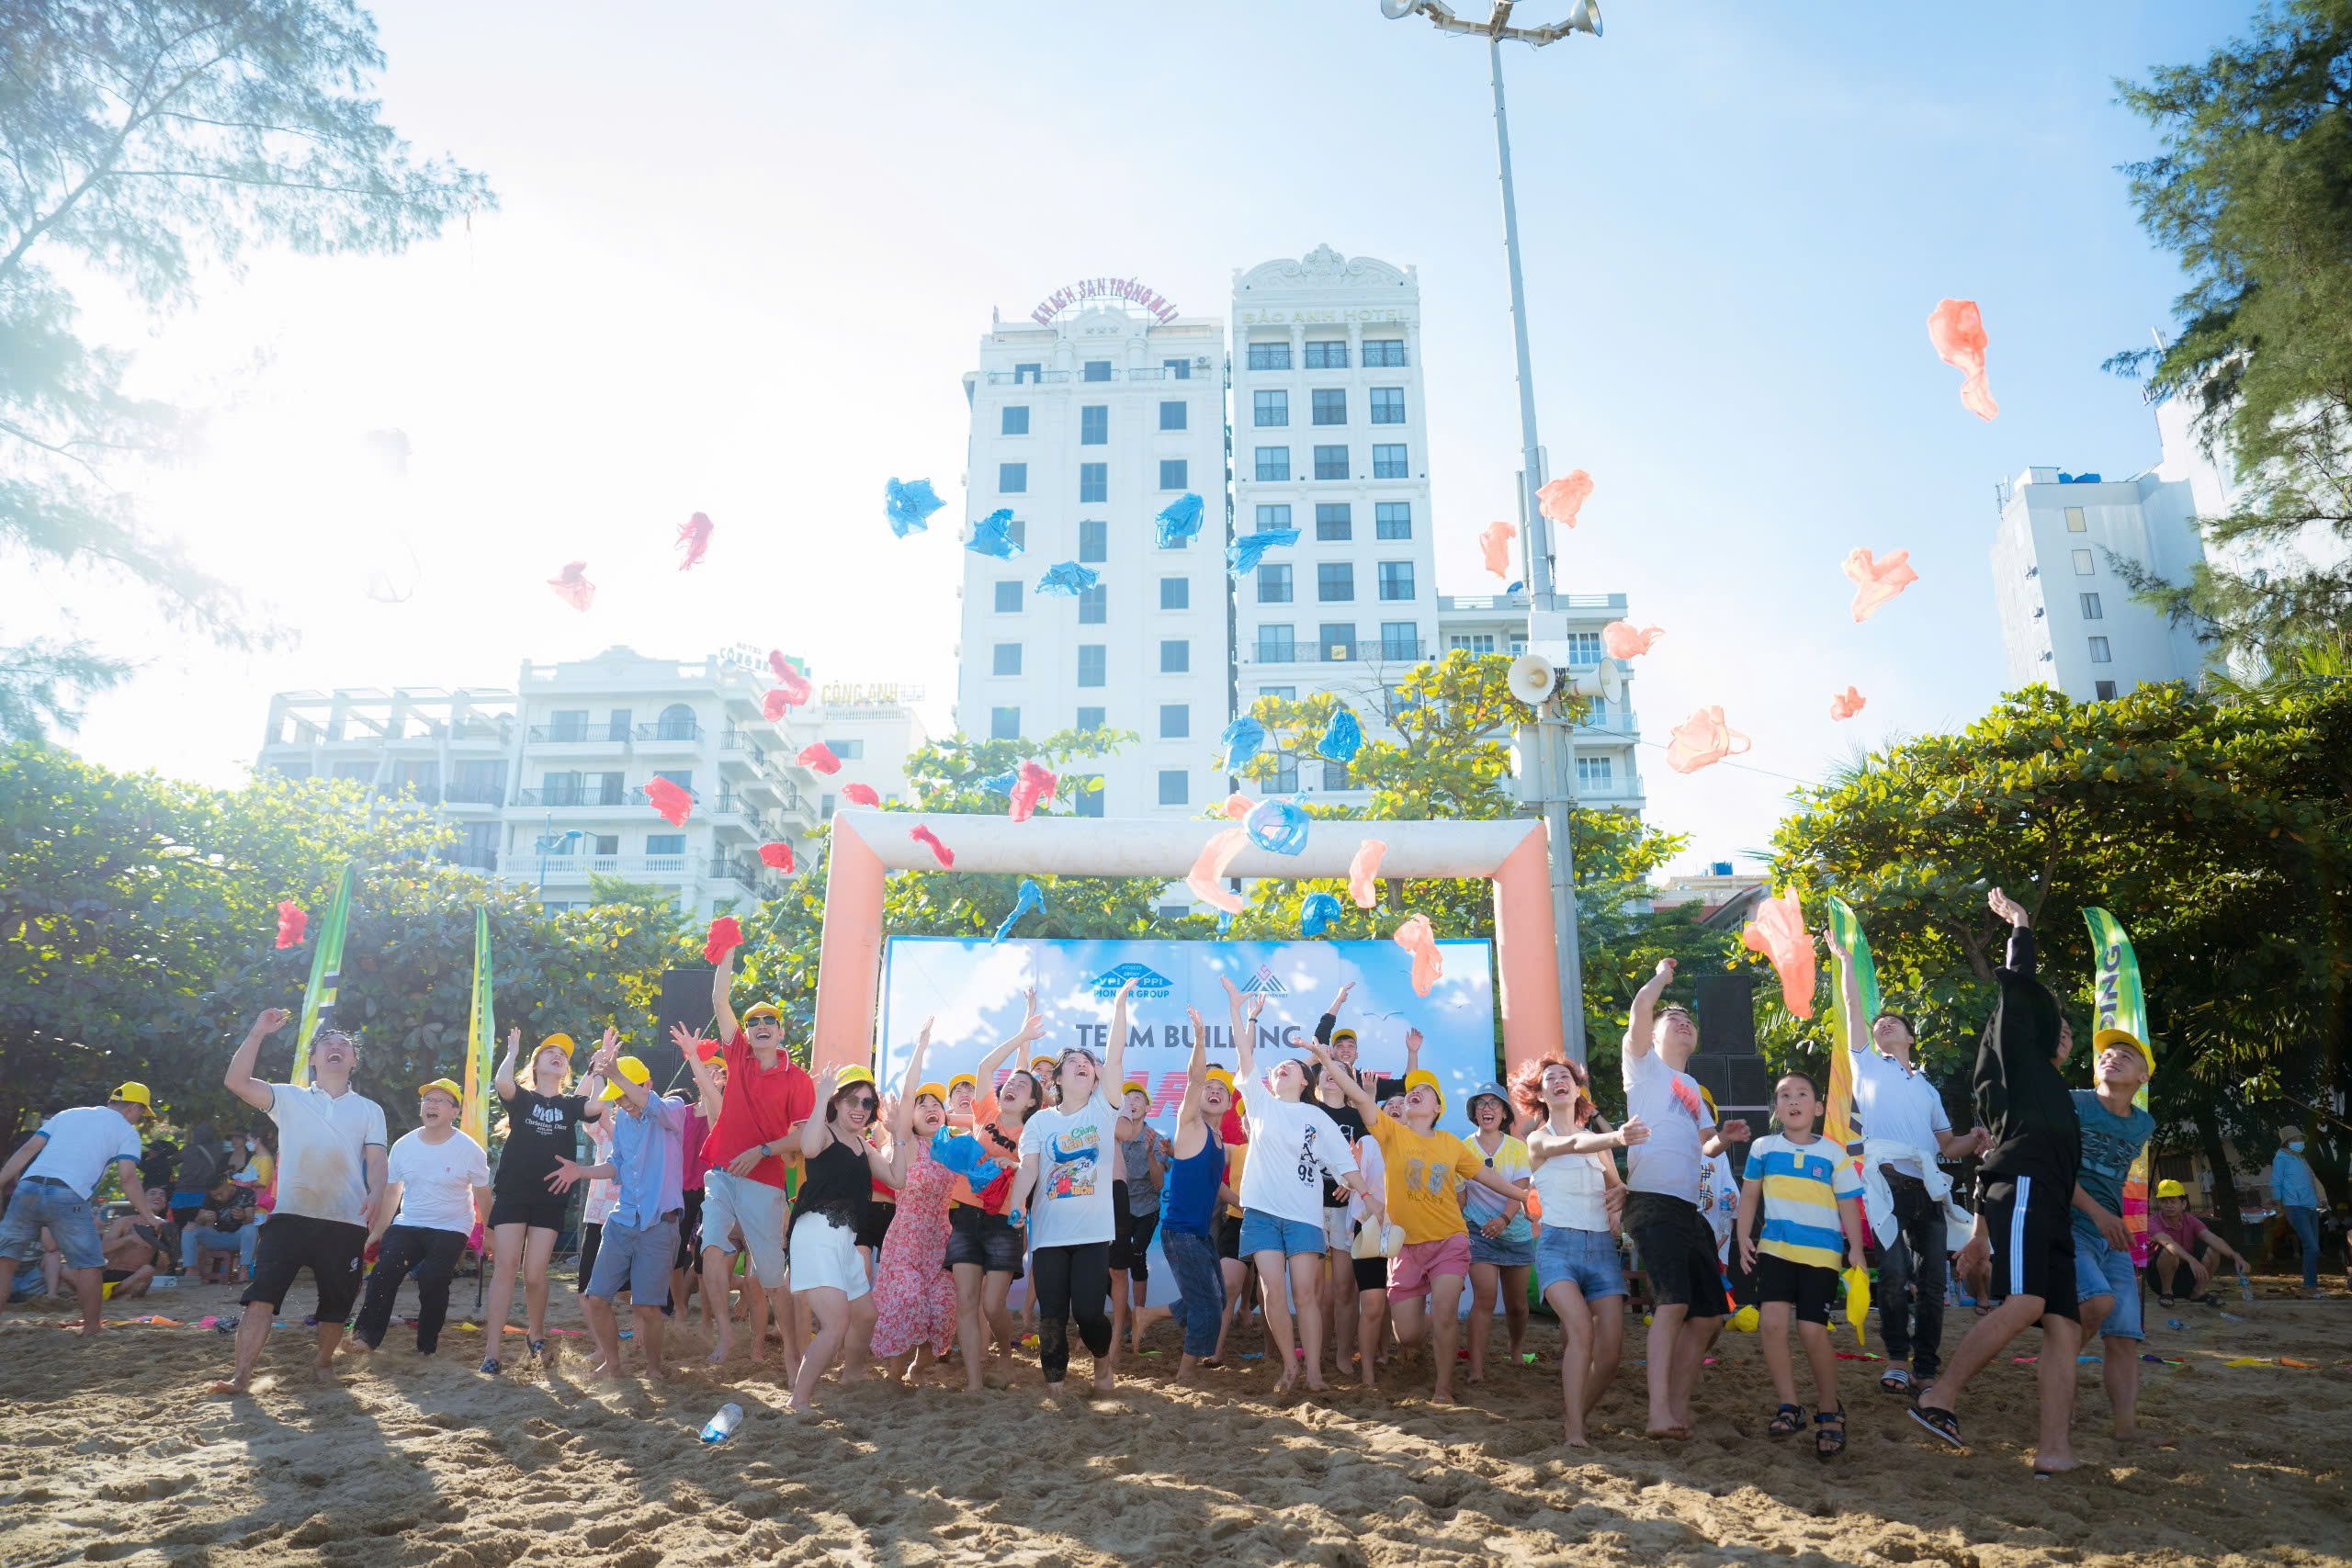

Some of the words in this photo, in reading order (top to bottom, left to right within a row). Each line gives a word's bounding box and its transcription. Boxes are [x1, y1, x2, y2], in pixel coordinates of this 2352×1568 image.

[1293, 309, 1336, 322] ANH
[1344, 308, 1411, 321] HOTEL
[1099, 977, 1121, 986] VPI
[1136, 990, 1170, 998] GROUP
[1076, 1024, 1155, 1048] TEM
[1164, 1025, 1301, 1049] BUILING
[525, 1118, 553, 1129] Christian
